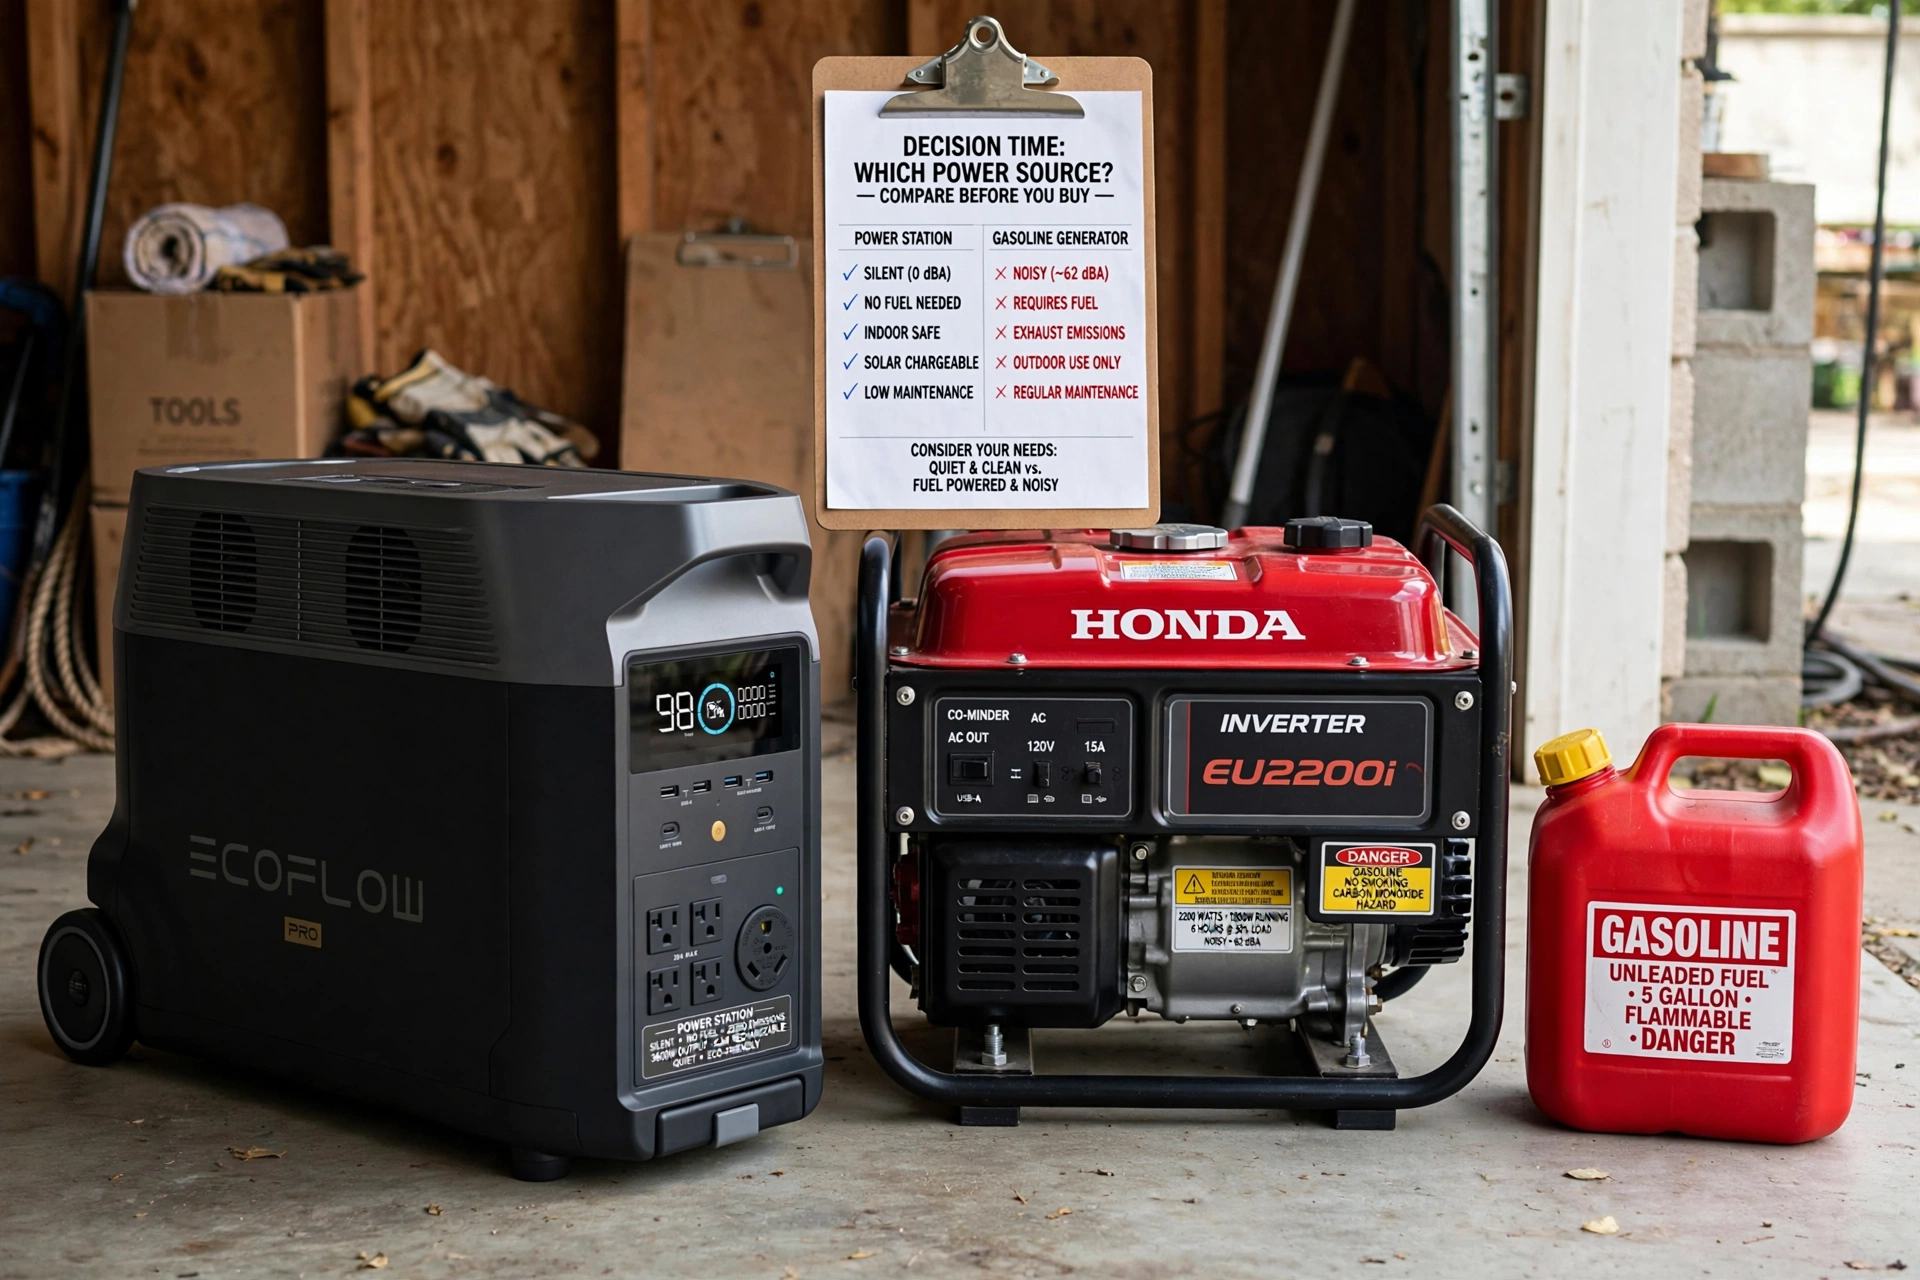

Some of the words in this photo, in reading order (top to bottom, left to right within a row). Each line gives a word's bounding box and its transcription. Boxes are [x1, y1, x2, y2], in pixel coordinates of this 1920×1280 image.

[903, 135, 1001, 157] DECISION
[1007, 135, 1065, 157] TIME:
[853, 161, 925, 184] WHICH
[933, 161, 1010, 184] POWER
[1016, 161, 1114, 184] SOURCE?
[879, 187, 955, 204] COMPARE
[959, 187, 1019, 204] BEFORE
[1023, 187, 1055, 204] YOU
[1059, 187, 1090, 204] BUY
[854, 230, 899, 246] POWER
[901, 230, 953, 246] STATION
[992, 230, 1054, 246] GASOLINE
[1056, 230, 1129, 246] GENERATOR
[864, 265, 905, 281] SILENT
[907, 265, 920, 283] (0
[923, 265, 951, 283] dBA)
[1013, 265, 1048, 281] NOISY
[1050, 265, 1078, 283] (~62
[1081, 265, 1109, 283] dBA)
[864, 295, 882, 310] NO
[884, 295, 913, 310] FUEL
[916, 295, 962, 310] NEEDED
[1013, 295, 1068, 311] REQUIRES
[1071, 295, 1099, 310] FUEL
[864, 325, 909, 340] INDOOR
[911, 325, 941, 340] SAFE
[1013, 325, 1064, 340] EXHAUST
[1066, 325, 1126, 340] EMISSIONS
[864, 355, 902, 370] SOLAR
[905, 355, 979, 370] CHARGEABLE
[1013, 355, 1066, 370] OUTDOOR
[1069, 355, 1090, 370] USE
[1092, 355, 1122, 370] ONLY
[864, 385, 890, 400] LOW
[893, 385, 974, 400] MAINTENANCE
[1013, 385, 1062, 400] REGULAR
[1064, 385, 1139, 400] MAINTENANCE
[148, 397, 241, 426] TOOLS
[910, 442, 973, 457] CONSIDER
[975, 442, 1010, 457] YOUR
[1013, 442, 1057, 457] NEEDS:
[928, 460, 966, 475] QUIET
[969, 460, 978, 475] &
[981, 460, 1022, 475] CLEAN
[1024, 463, 1042, 475] vs.
[913, 478, 944, 492] FUEL
[946, 478, 1007, 492] POWERED
[1009, 478, 1019, 492] &
[1022, 478, 1059, 492] NOISY
[1071, 608, 1307, 641] HONDA
[656, 691, 694, 733] 98
[947, 709, 1010, 721] CO-MINDER
[1030, 712, 1047, 724] AC
[1220, 713, 1366, 734] INVERTER
[947, 731, 964, 743] AC
[966, 731, 990, 744] OUT
[1027, 740, 1055, 752] 120V
[1084, 740, 1106, 753] 15A
[1202, 758, 1397, 786] EU2200i
[1347, 850, 1410, 864] DANGER
[190, 834, 424, 923] ECOFLOW
[1344, 877, 1359, 887] NO
[1356, 899, 1397, 910] HAZARD
[288, 922, 318, 942] PRO
[1601, 914, 1781, 961] GASOLINE
[1609, 963, 1714, 986] UNLEADED
[1720, 969, 1769, 989] FUEL
[1641, 986, 1653, 1004] 5
[1658, 987, 1739, 1009] GALLON
[677, 1016, 712, 1034] POWER
[714, 1007, 754, 1026] STATION
[1624, 1005, 1752, 1030] FLAMMABLE
[1641, 1027, 1736, 1056] DANGER
